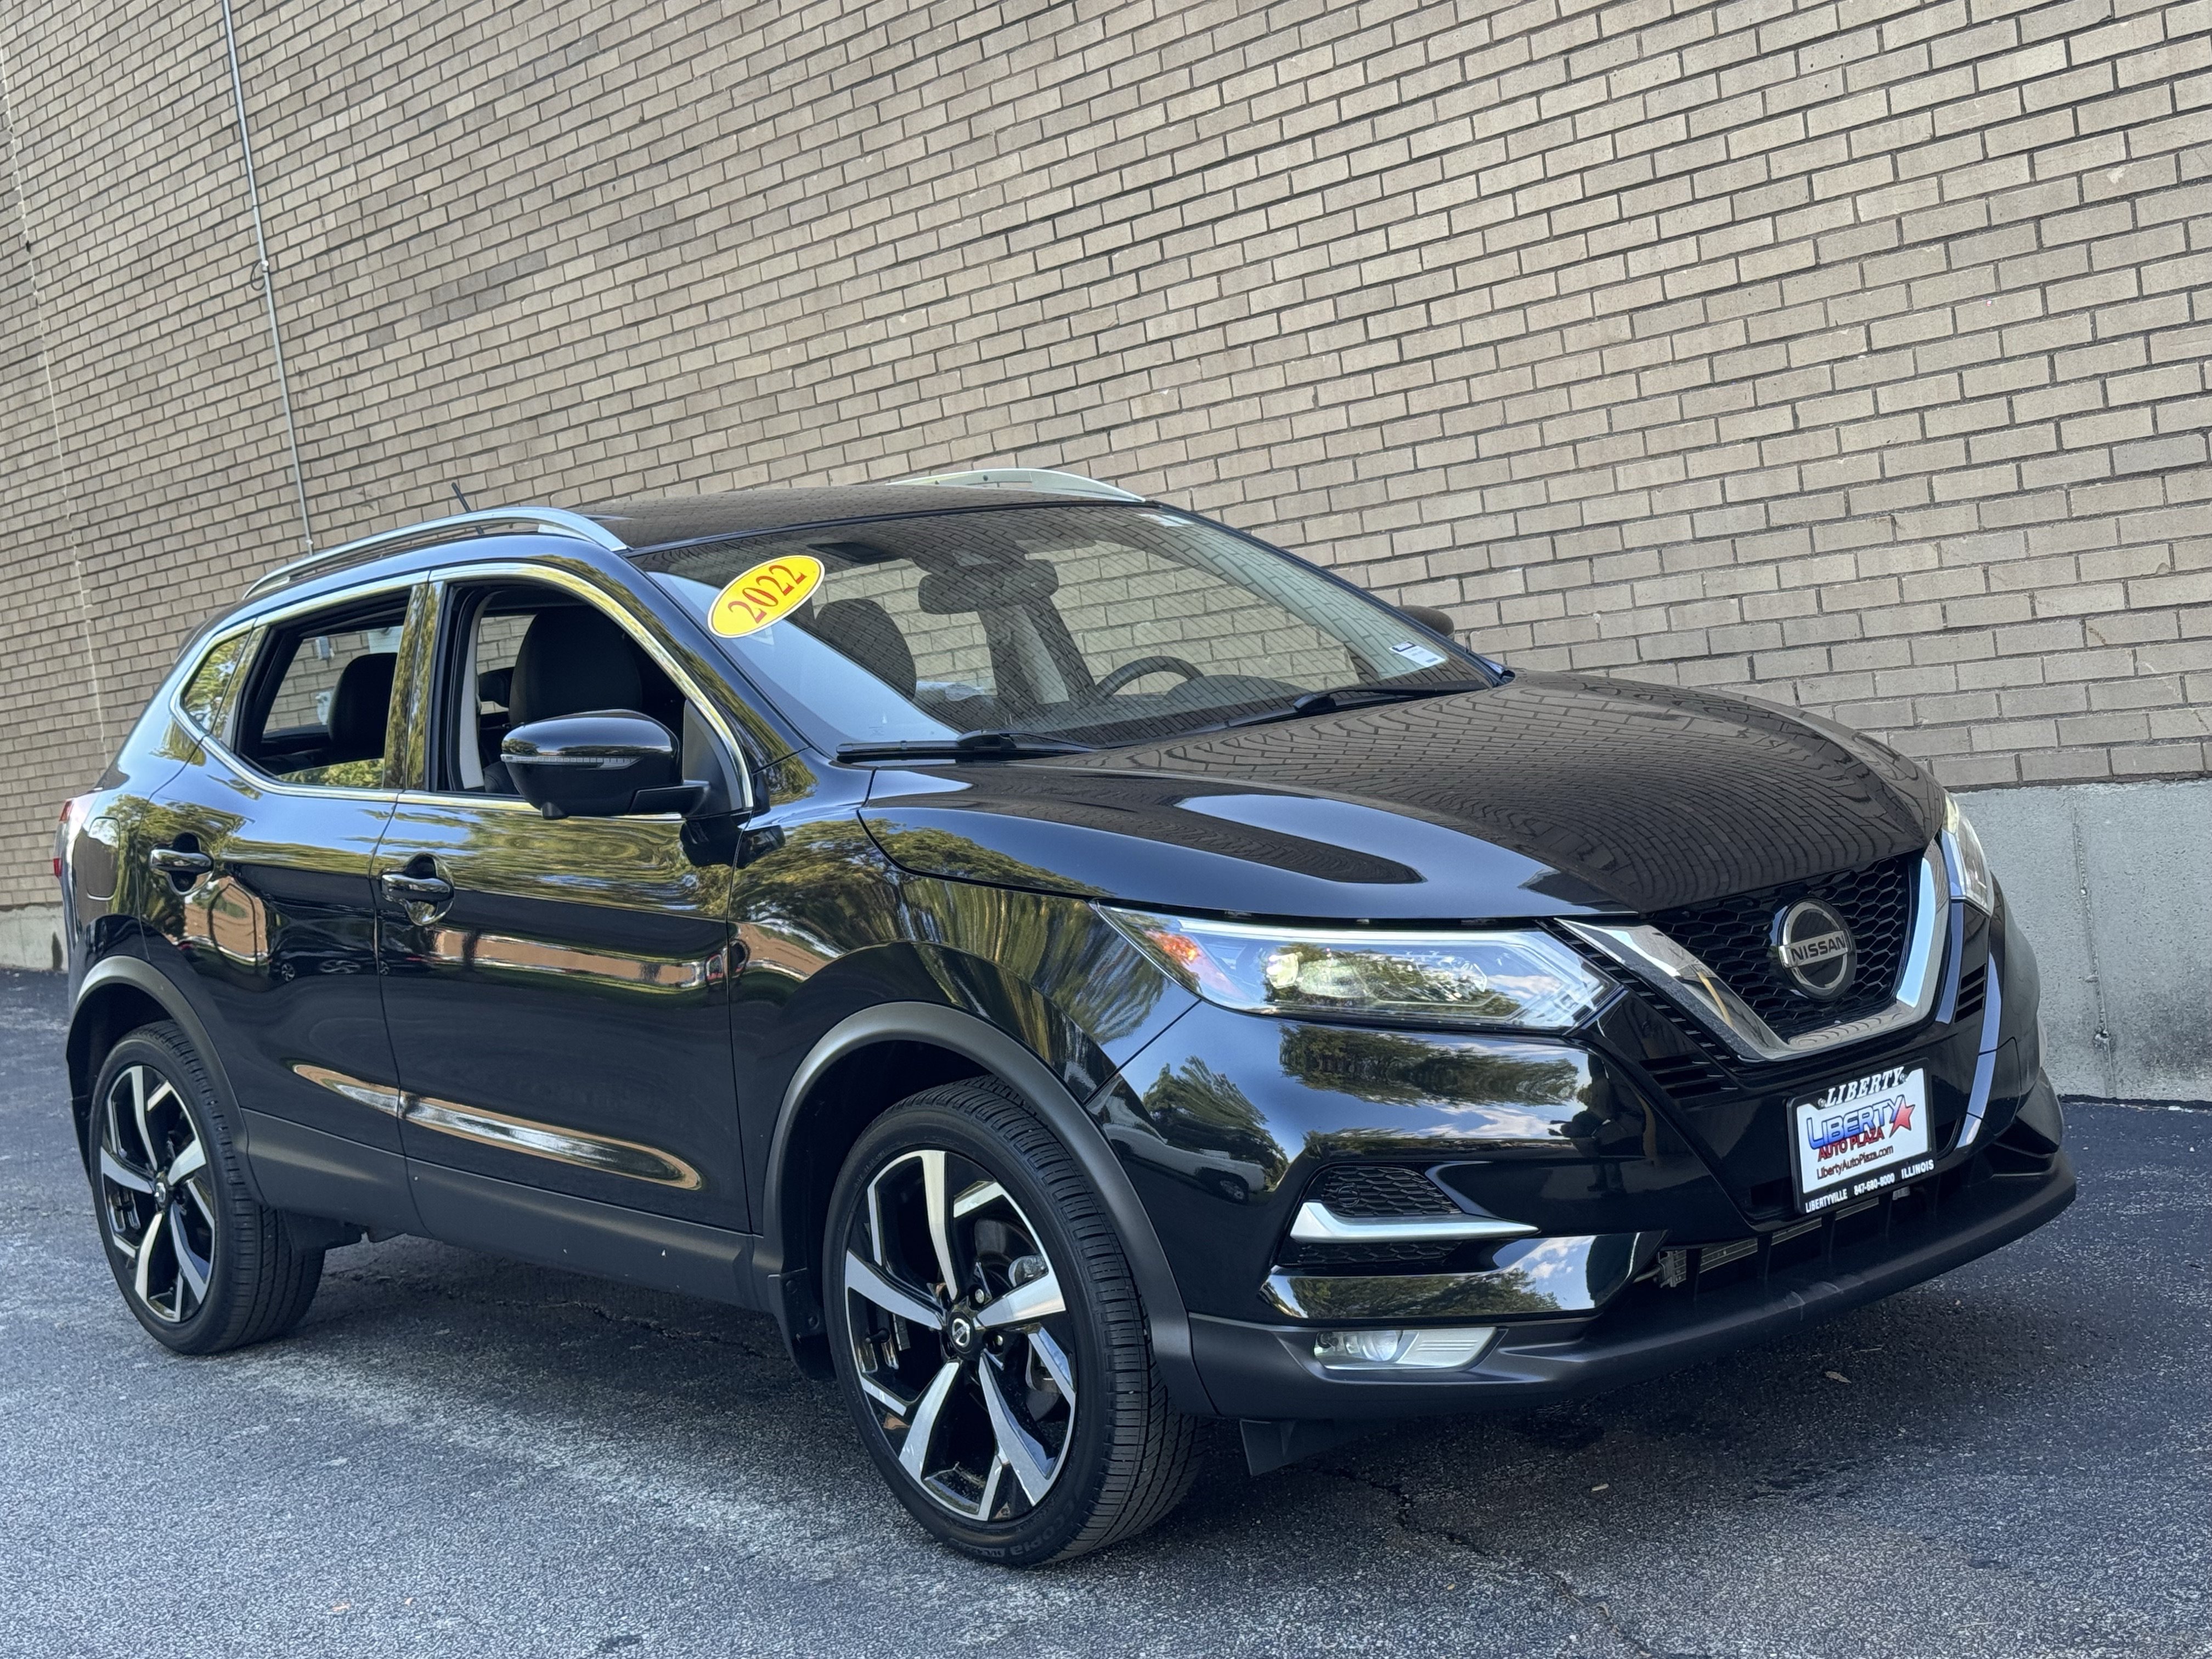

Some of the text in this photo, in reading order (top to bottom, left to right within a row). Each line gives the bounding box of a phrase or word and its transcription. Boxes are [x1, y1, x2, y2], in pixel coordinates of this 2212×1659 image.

[727, 565, 808, 624] 2022
[1791, 936, 1846, 962] NISSAN
[1825, 1066, 1904, 1108] LIBERTY
[1807, 1094, 1905, 1149] LIBERTY
[1816, 1146, 1894, 1180] LibertyAutoPlaza.com
[1817, 1127, 1885, 1162] AUTO PLAZA
[1805, 1188, 1848, 1213] LIBERTYVILLE
[1901, 1159, 1934, 1179] ILLINOIS
